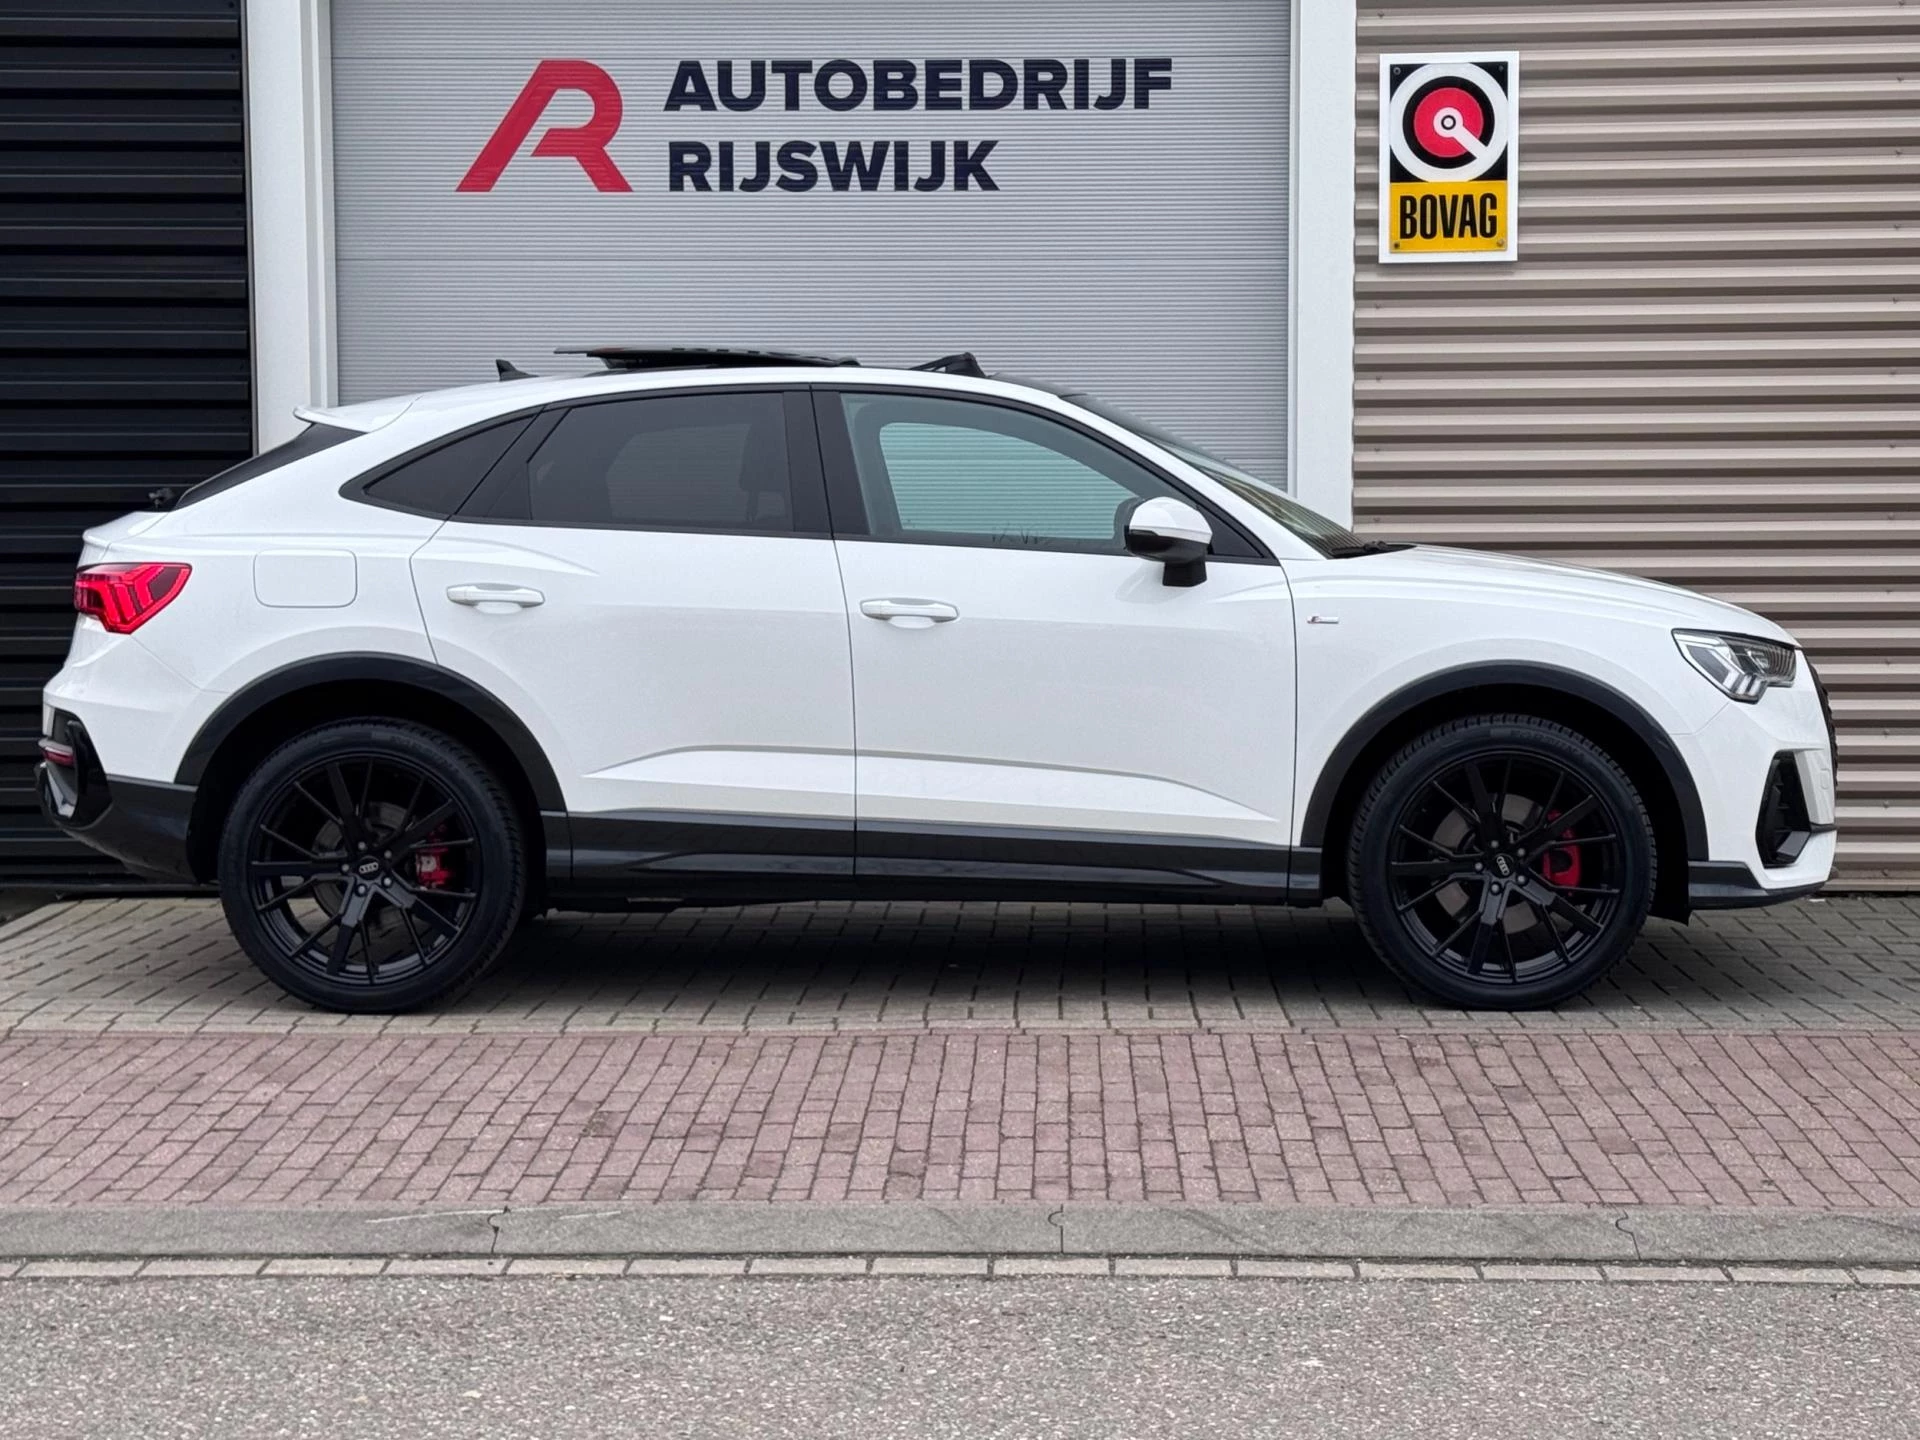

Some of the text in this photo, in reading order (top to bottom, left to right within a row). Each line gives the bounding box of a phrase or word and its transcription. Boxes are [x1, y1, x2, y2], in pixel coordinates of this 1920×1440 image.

[663, 57, 1173, 112] AUTOBEDRIJF
[668, 139, 1001, 193] RIJSWIJK
[1399, 192, 1498, 240] BOVAG
